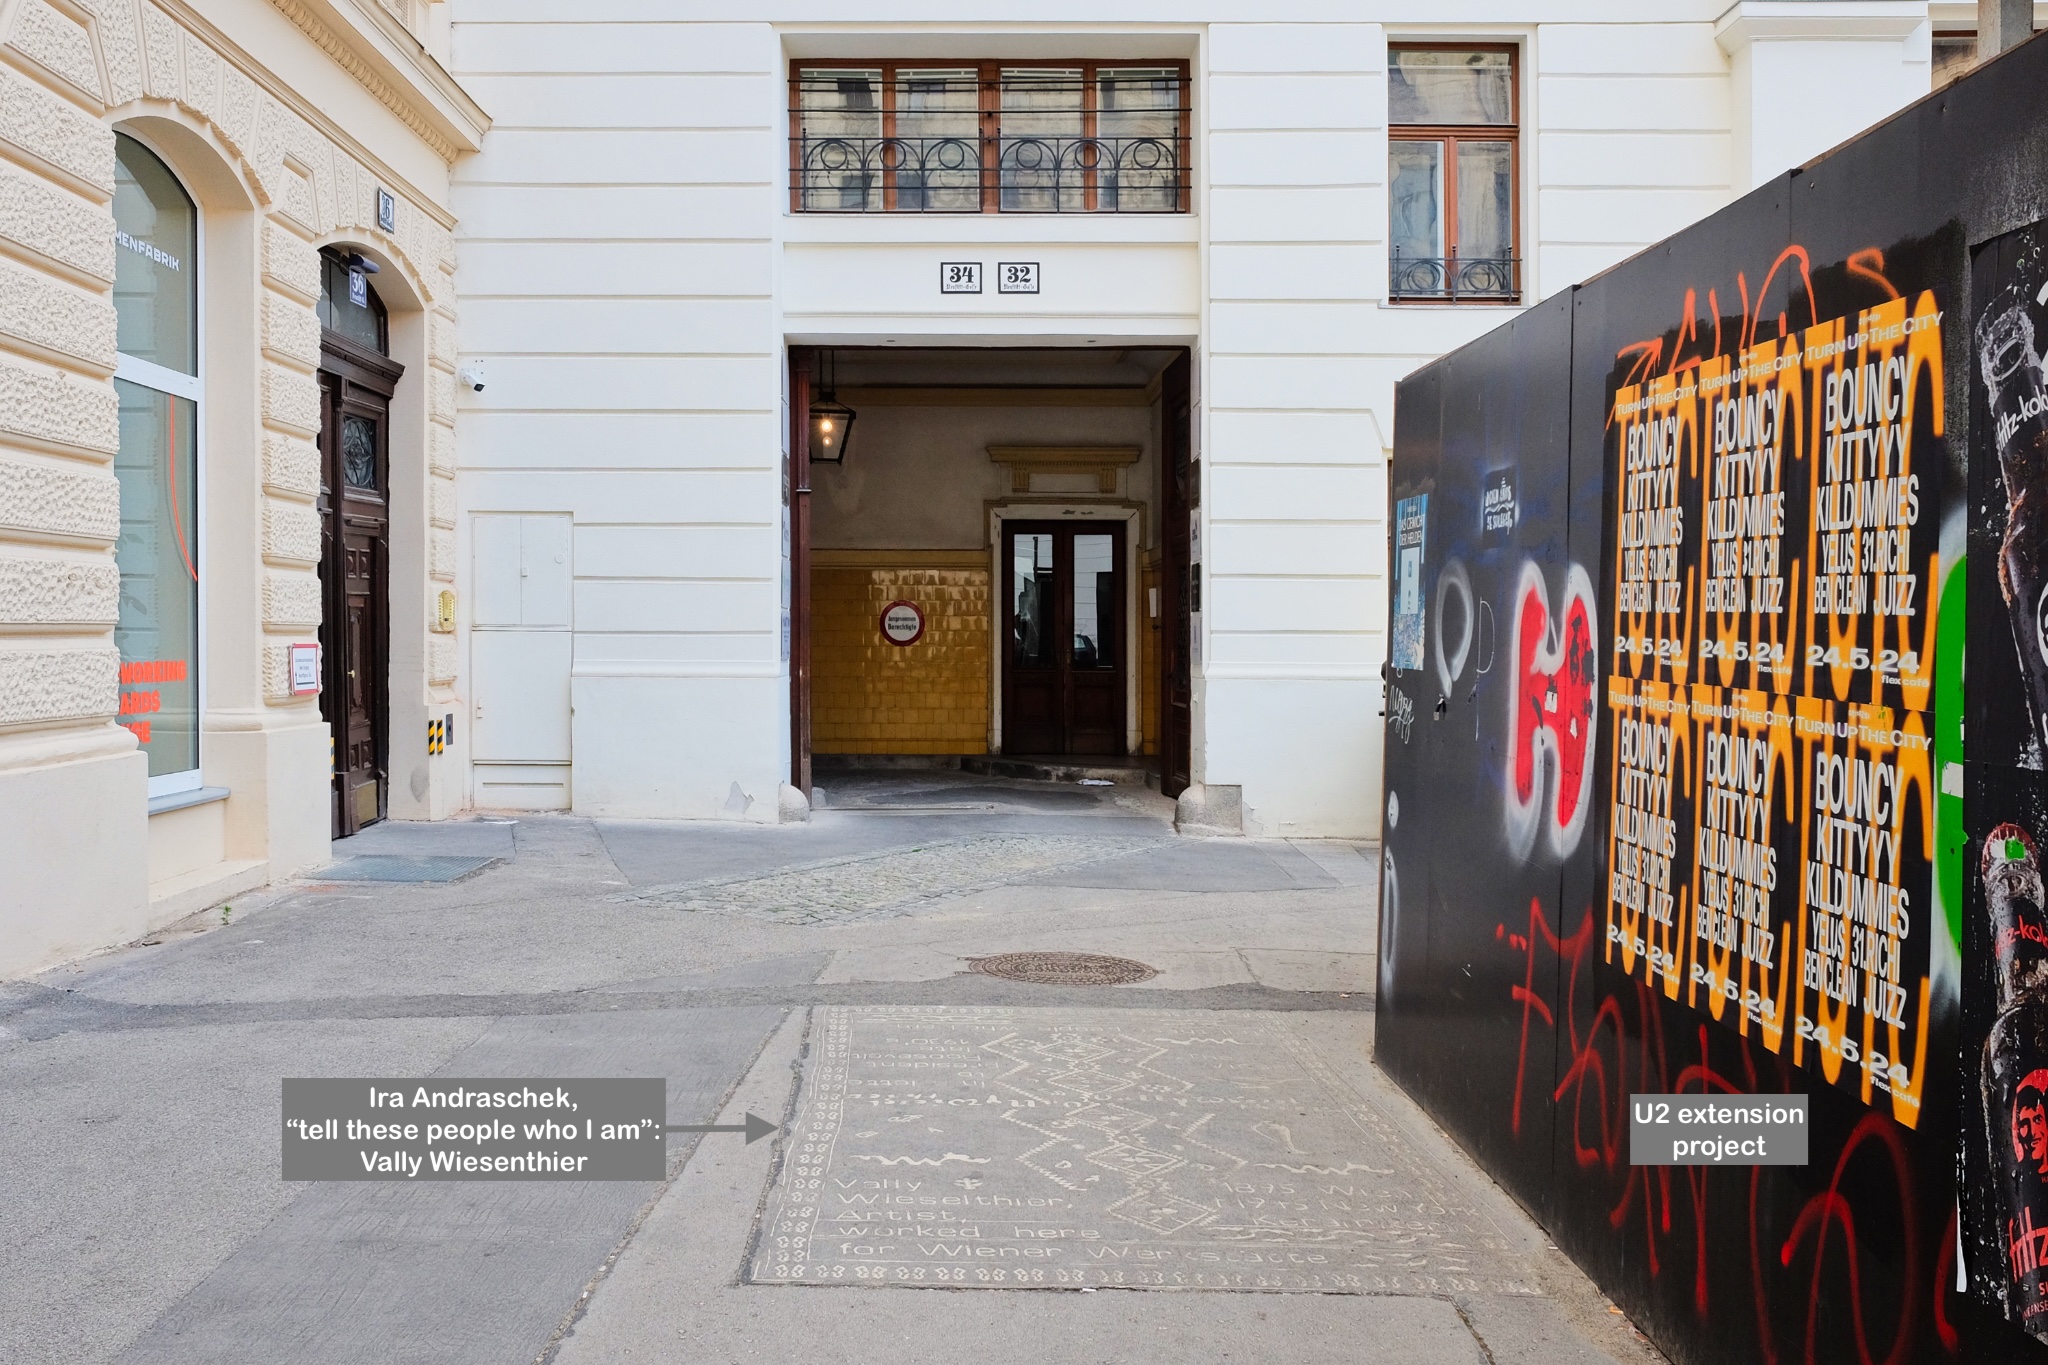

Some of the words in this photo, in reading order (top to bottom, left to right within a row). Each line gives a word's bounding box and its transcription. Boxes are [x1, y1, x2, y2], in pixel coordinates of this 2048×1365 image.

[352, 272, 364, 295] 36
[950, 266, 974, 284] 34
[1007, 266, 1032, 284] 32
[1806, 339, 1845, 361] TURN
[1847, 333, 1868, 350] UP
[1869, 324, 1899, 343] THE
[1902, 311, 1944, 334] CITY
[1701, 374, 1732, 391] TURN
[1732, 368, 1748, 383] UP
[1749, 362, 1771, 379] THE
[1773, 352, 1803, 371] CITY
[1825, 353, 1915, 432] BOUNCY
[1616, 402, 1641, 416] TURN
[1642, 396, 1654, 410] UP
[1655, 392, 1672, 407] THE
[1674, 385, 1698, 400] CITY
[1715, 387, 1784, 453] BOUNCY
[1628, 415, 1681, 471] BOUNCY
[1826, 421, 1910, 483] KITTYYY
[1628, 466, 1678, 511] KITTYYY
[1715, 446, 1781, 498] KITTYYY
[1708, 491, 1785, 540] KILLDUMMIES
[1816, 474, 1919, 531] KILLDUMMIES
[1622, 506, 1683, 548] KILLDUMMIES
[1625, 549, 1646, 581] YELUS
[1712, 541, 1738, 577] YELUS
[1822, 532, 1855, 574] YELUS
[1655, 581, 1681, 613] JUIZZ
[1751, 577, 1784, 613] JUIZZ
[1873, 574, 1916, 616] JUIZZ
[1615, 636, 1682, 657] 24.5.24
[1700, 639, 1784, 663] 24.5.24
[1807, 645, 1919, 675] 24.5.24
[118, 659, 187, 685] WORKING
[1881, 675, 1901, 685] flex
[1609, 691, 1634, 705] TURN
[1635, 695, 1647, 708] UP
[1648, 696, 1665, 711] THE
[1666, 700, 1690, 715] CITY
[1692, 700, 1722, 717] TURN
[1723, 705, 1739, 719] UP
[1740, 707, 1762, 724] THE
[1764, 711, 1793, 728] CITY
[1621, 717, 1674, 774] BOUNCY
[1796, 716, 1835, 736] TURN
[1837, 722, 1858, 739] UP
[1859, 724, 1888, 745] THE
[1890, 729, 1932, 750] CITY
[1707, 730, 1774, 796] BOUNCY
[1621, 766, 1672, 816] KITTYYY
[1816, 751, 1904, 828] BOUNCY
[1615, 802, 1676, 859] KILLDUMMIES
[1707, 785, 1770, 842] KITTYYY
[1618, 841, 1639, 880] YELUS
[1699, 820, 1777, 892] KILLDUMMIES
[1816, 814, 1900, 883] KITTYYY
[1648, 888, 1674, 927] JUIZZ
[1704, 870, 1729, 913] YELUS
[1806, 860, 1910, 940] KILLDUMMIES
[1607, 924, 1674, 971] 24.5.24
[1742, 924, 1774, 969] JUIZZ
[1812, 910, 1846, 961] YELUS
[1690, 963, 1775, 1020] 24.5.24
[1863, 975, 1907, 1030] JUIZZ
[1796, 1015, 1910, 1089] 24.5.24
[1870, 1076, 1890, 1092] flex
[834, 1178, 922, 1192] Vally
[835, 1209, 967, 1223] Artist,
[840, 1225, 980, 1237] worked
[1015, 1226, 1100, 1238] here
[840, 1243, 895, 1255] for
[917, 1244, 1062, 1257] Wiener
